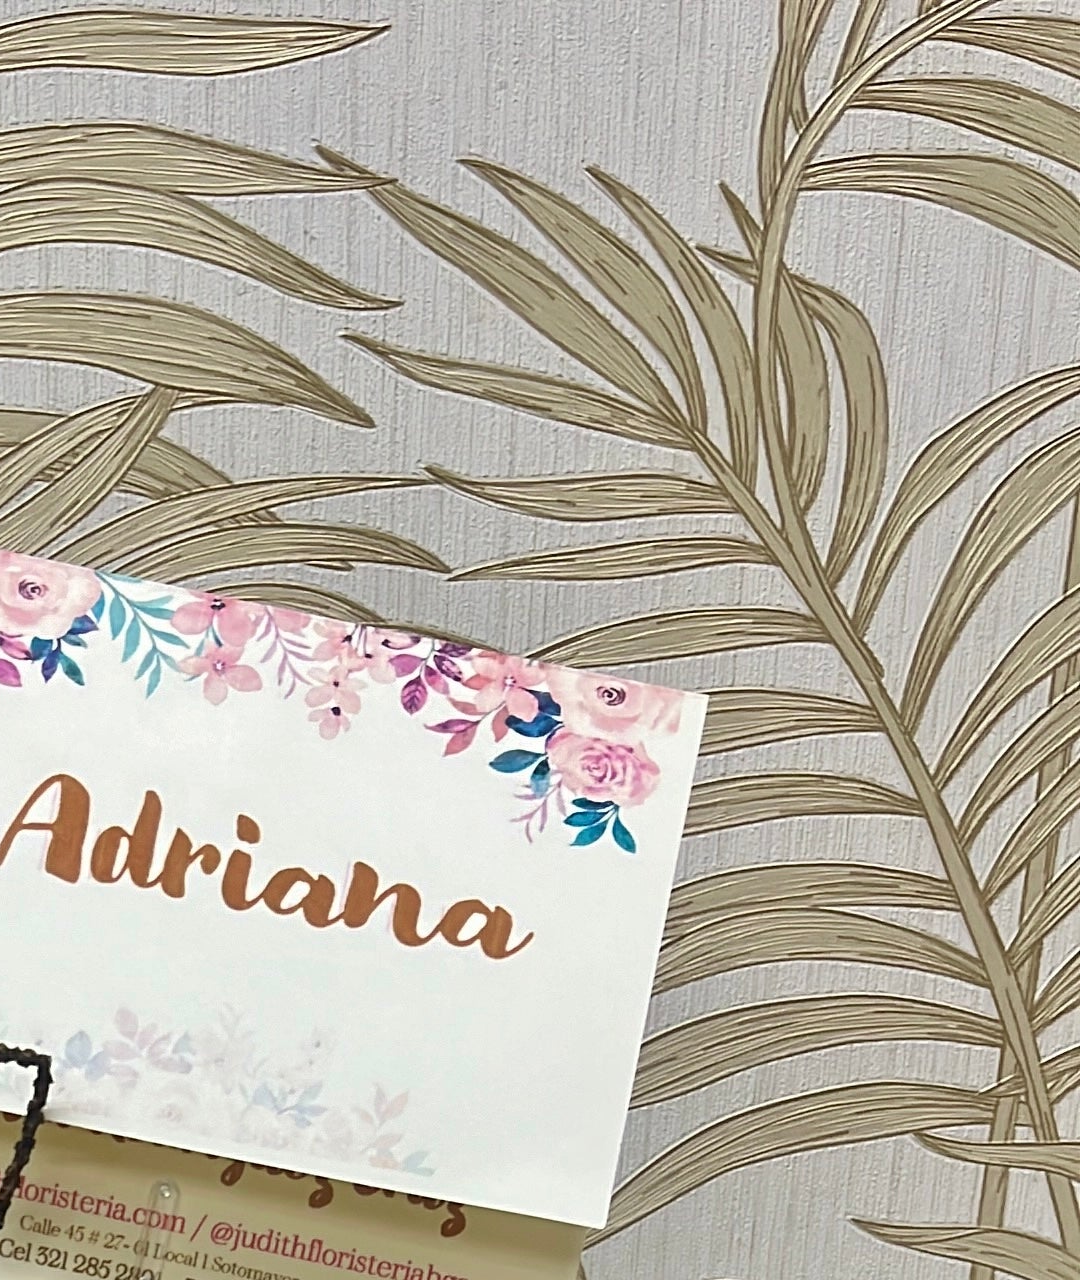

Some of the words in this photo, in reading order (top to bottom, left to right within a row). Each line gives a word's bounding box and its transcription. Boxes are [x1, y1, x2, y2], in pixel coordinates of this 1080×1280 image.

[20, 1214, 62, 1238] Calle
[65, 1223, 86, 1244] 45
[36, 1246, 68, 1271] 321
[73, 1253, 110, 1280] 285
